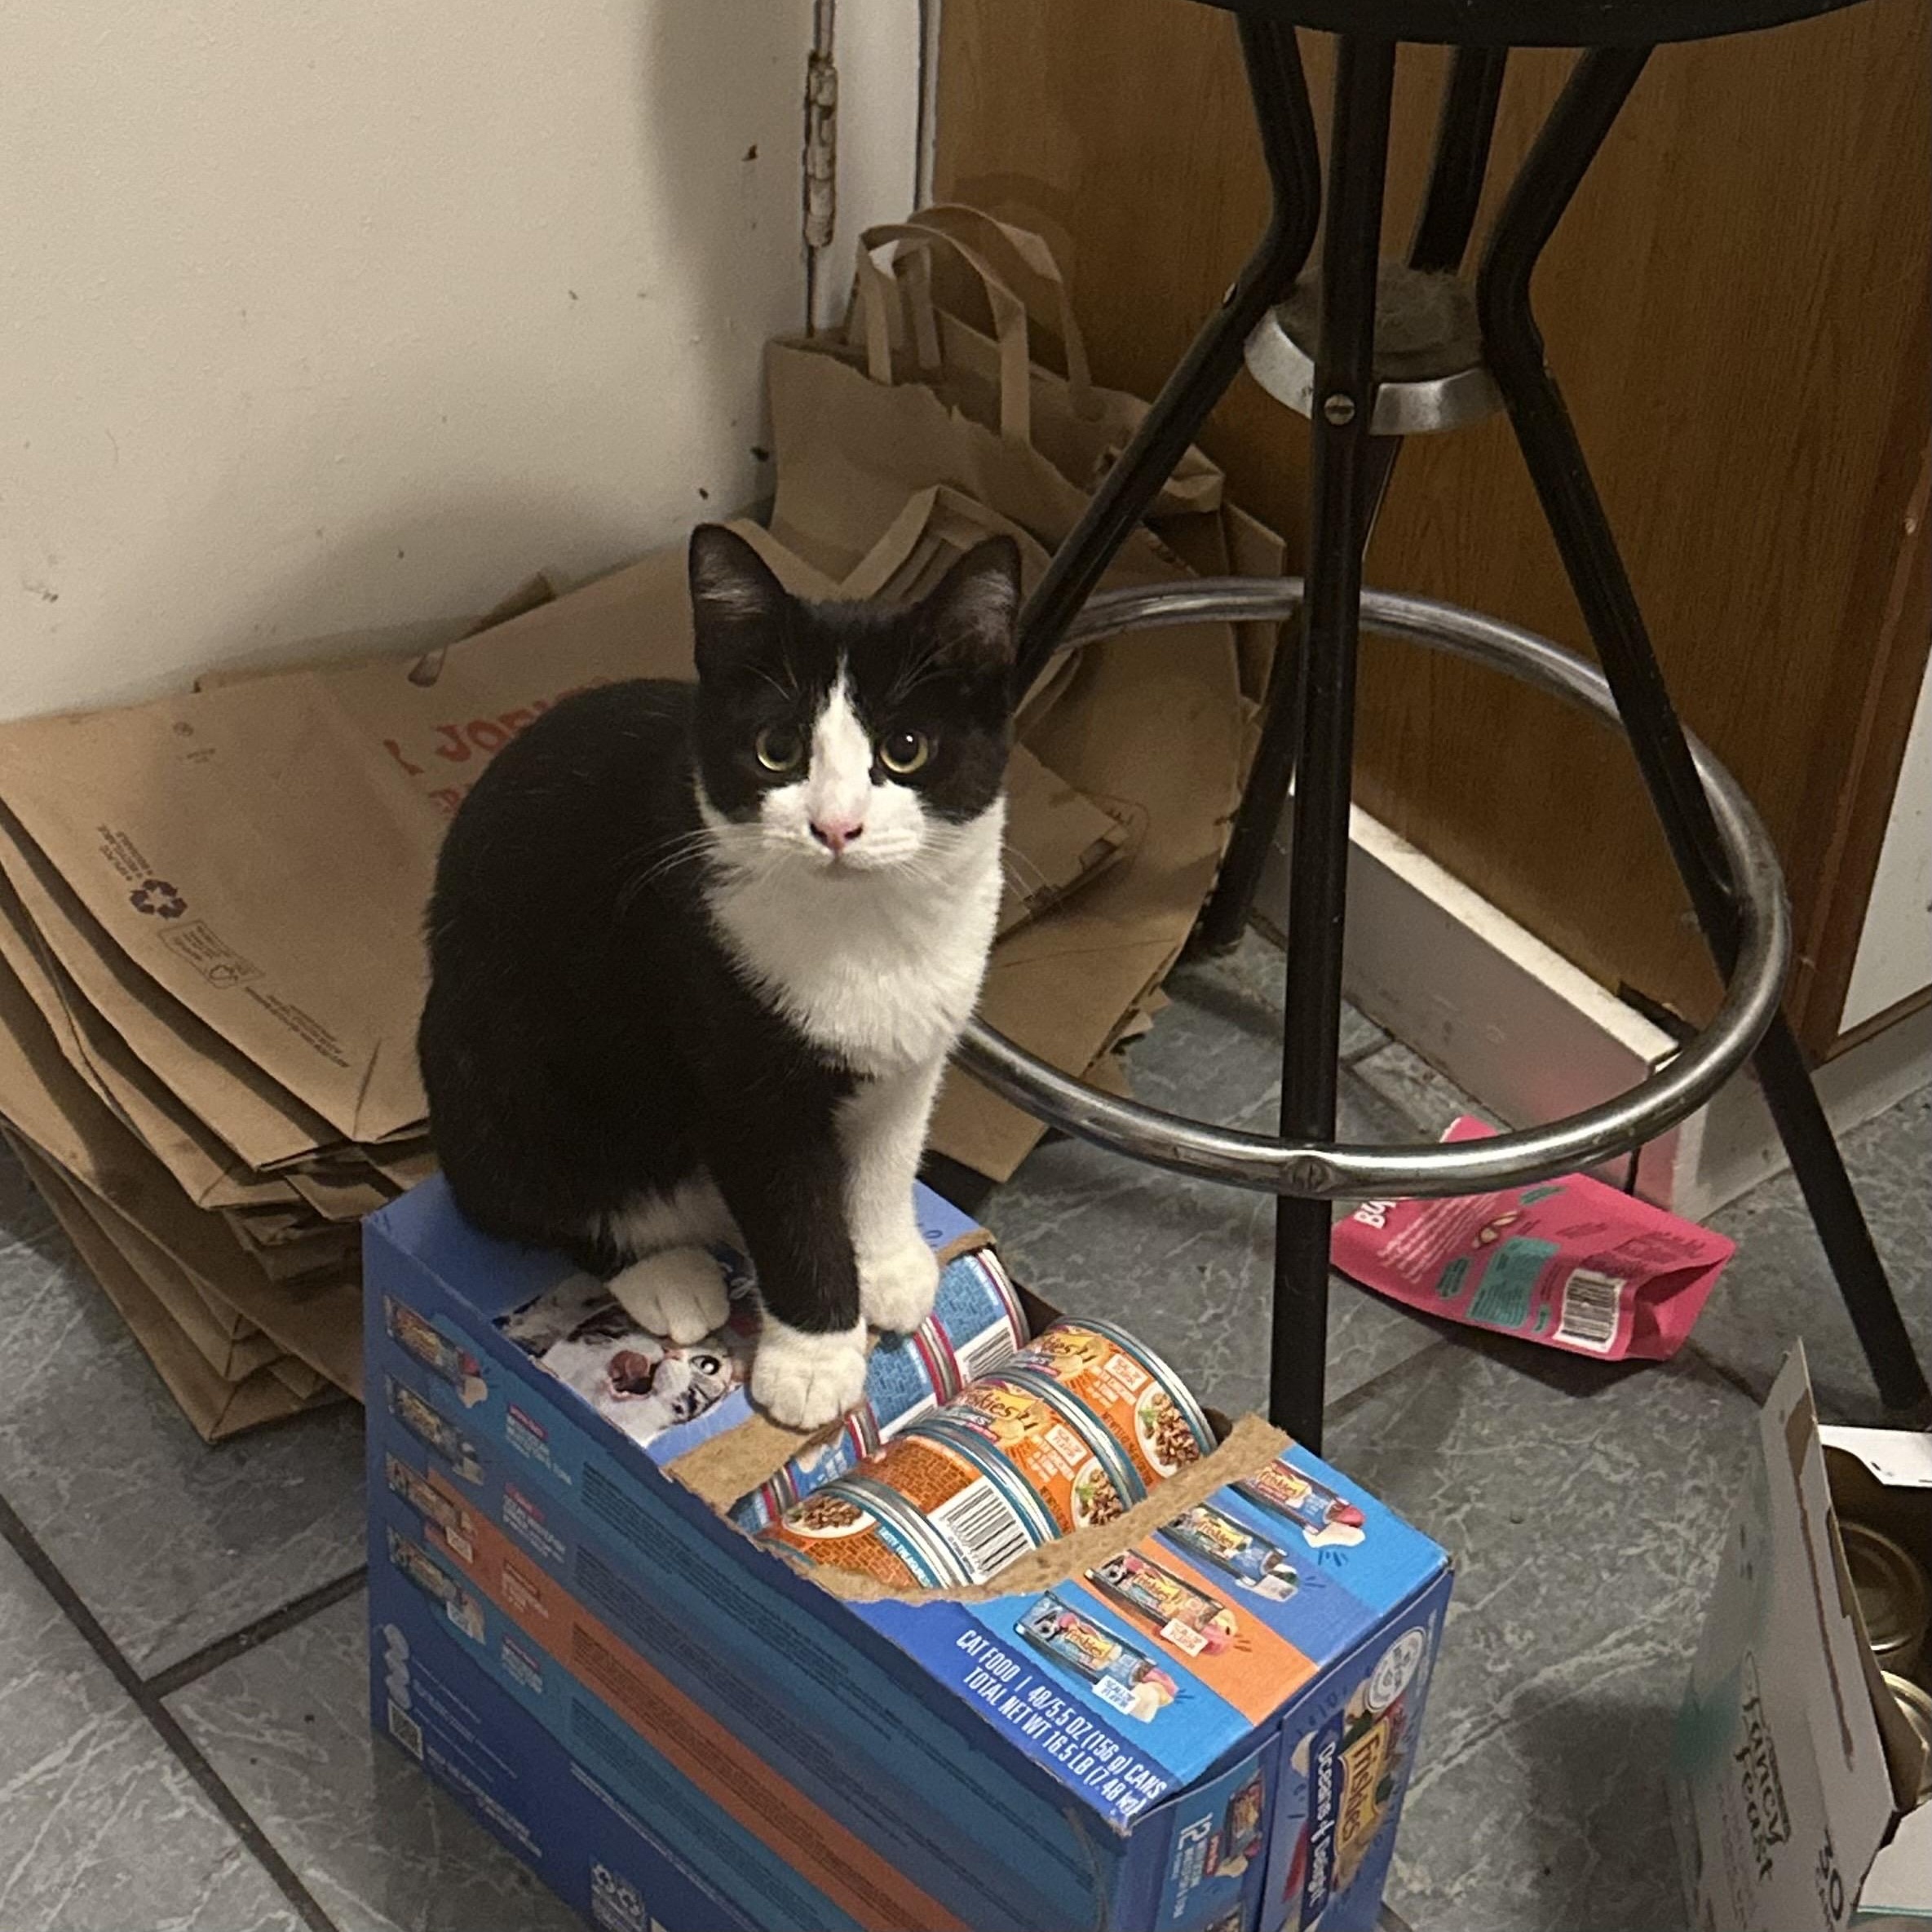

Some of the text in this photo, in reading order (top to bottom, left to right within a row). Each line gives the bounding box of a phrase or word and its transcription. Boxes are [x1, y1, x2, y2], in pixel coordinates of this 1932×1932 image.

[956, 1630, 1168, 1800] CAT FOOD 48/5.5 OZ (156 g) CANS
[963, 1666, 1007, 1707] TOTAL
[998, 1695, 1033, 1724] NET
[1021, 1713, 1052, 1740] WT
[1042, 1730, 1078, 1762] 16.5
[1068, 1744, 1095, 1775] LB
[1084, 1767, 1125, 1802] (7.48
[1317, 1741, 1336, 1820] Oceans
[1343, 1734, 1381, 1842] Friskies
